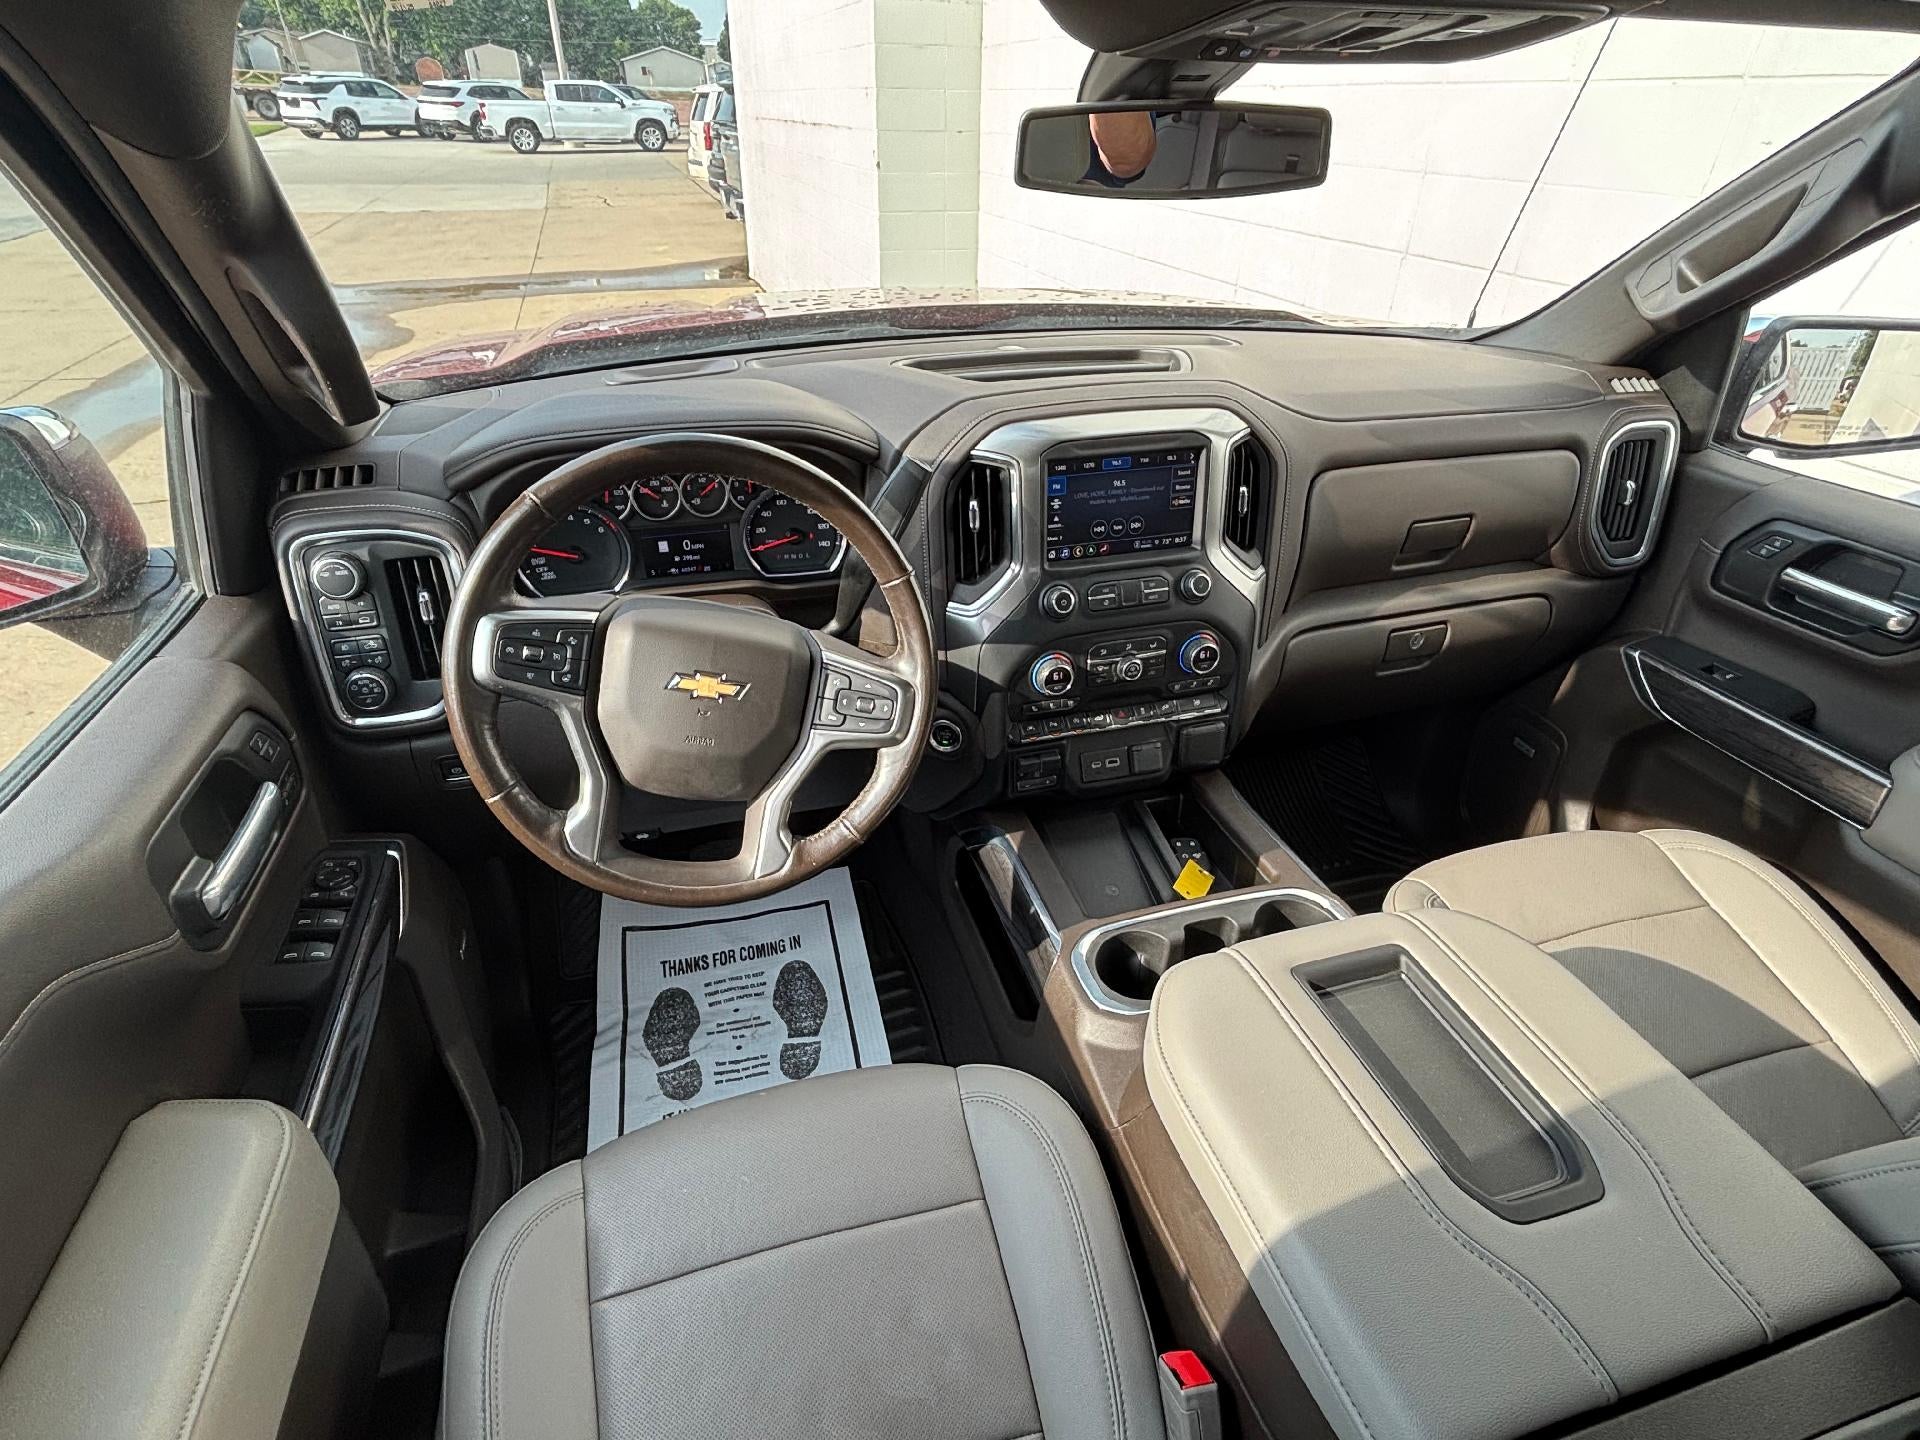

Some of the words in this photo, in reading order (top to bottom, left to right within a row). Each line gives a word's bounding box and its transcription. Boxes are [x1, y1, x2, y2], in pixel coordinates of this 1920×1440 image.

[1113, 479, 1126, 487] 96.5
[682, 539, 691, 551] 0
[1200, 650, 1210, 659] 61
[1053, 671, 1063, 680] 61
[659, 953, 710, 979] THANKS
[712, 948, 737, 969] FOR
[739, 938, 787, 962] COMING
[788, 933, 802, 951] IN
